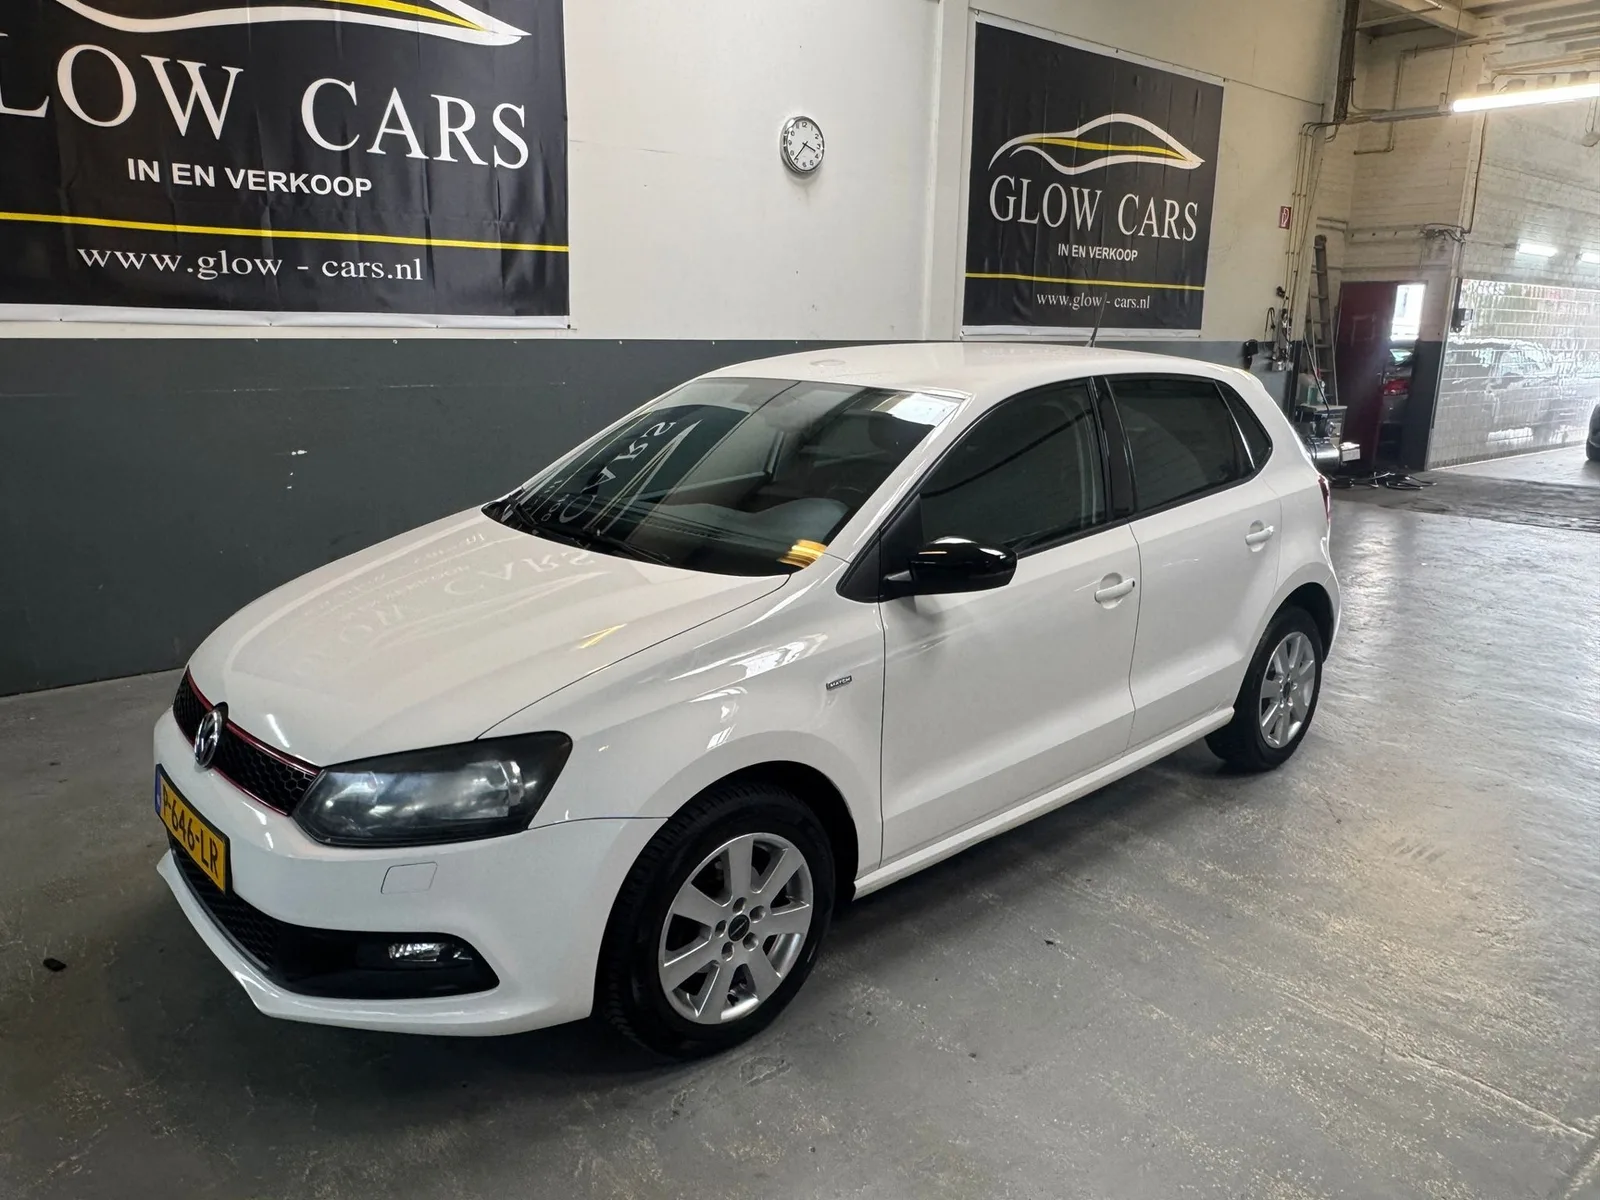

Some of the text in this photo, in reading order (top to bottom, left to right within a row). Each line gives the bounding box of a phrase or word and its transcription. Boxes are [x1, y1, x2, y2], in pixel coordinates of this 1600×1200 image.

[301, 77, 529, 170] CARS
[128, 158, 372, 198] IN EN VERKOOP
[989, 174, 1199, 242] GLOW CARS
[77, 248, 283, 281] www.glow
[321, 257, 424, 281] cars.nl
[1058, 243, 1138, 262] IN EN VERKOOP
[1037, 292, 1103, 311] www.glow
[1114, 295, 1151, 309] cars.nl
[163, 784, 219, 879] P-646-LR
